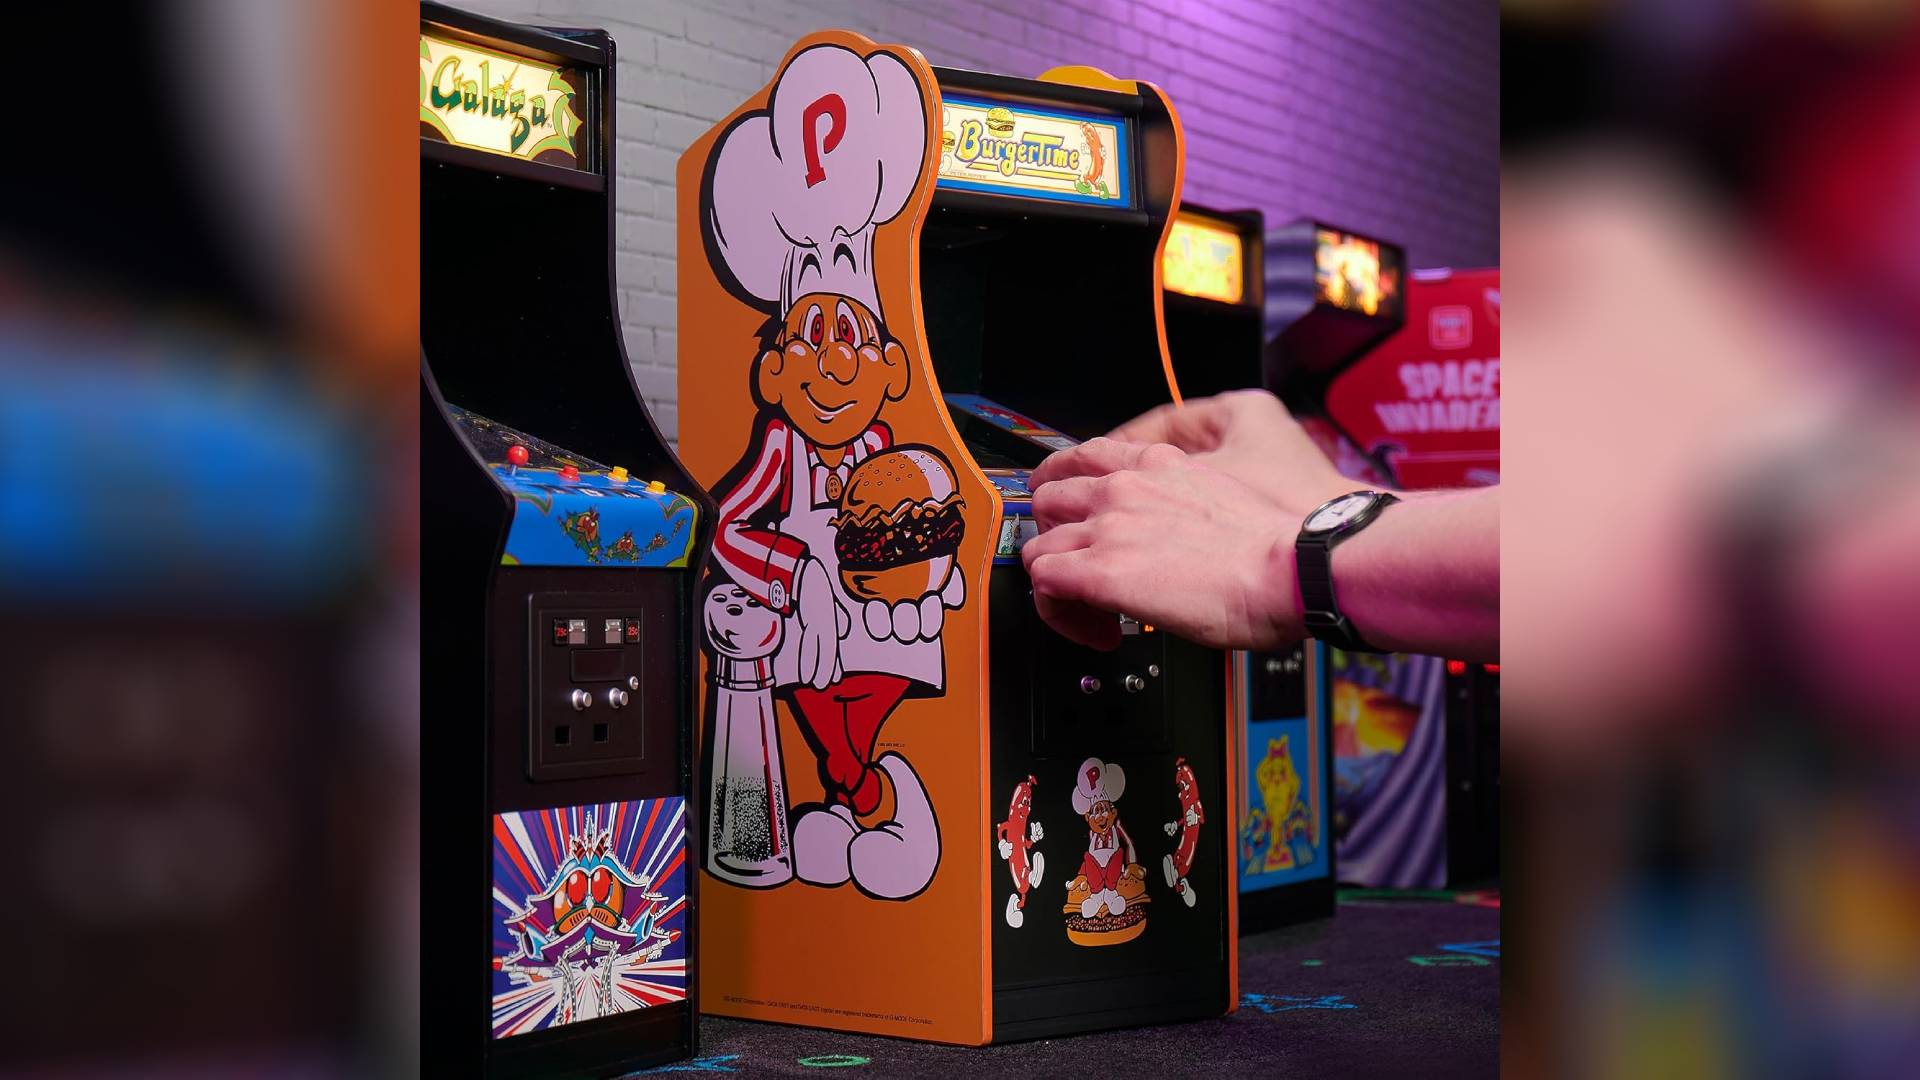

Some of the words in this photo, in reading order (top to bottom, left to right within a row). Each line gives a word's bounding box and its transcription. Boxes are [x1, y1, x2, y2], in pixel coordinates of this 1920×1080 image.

[430, 57, 549, 152] Galaga
[802, 92, 847, 189] P
[1398, 359, 1500, 399] SPACE
